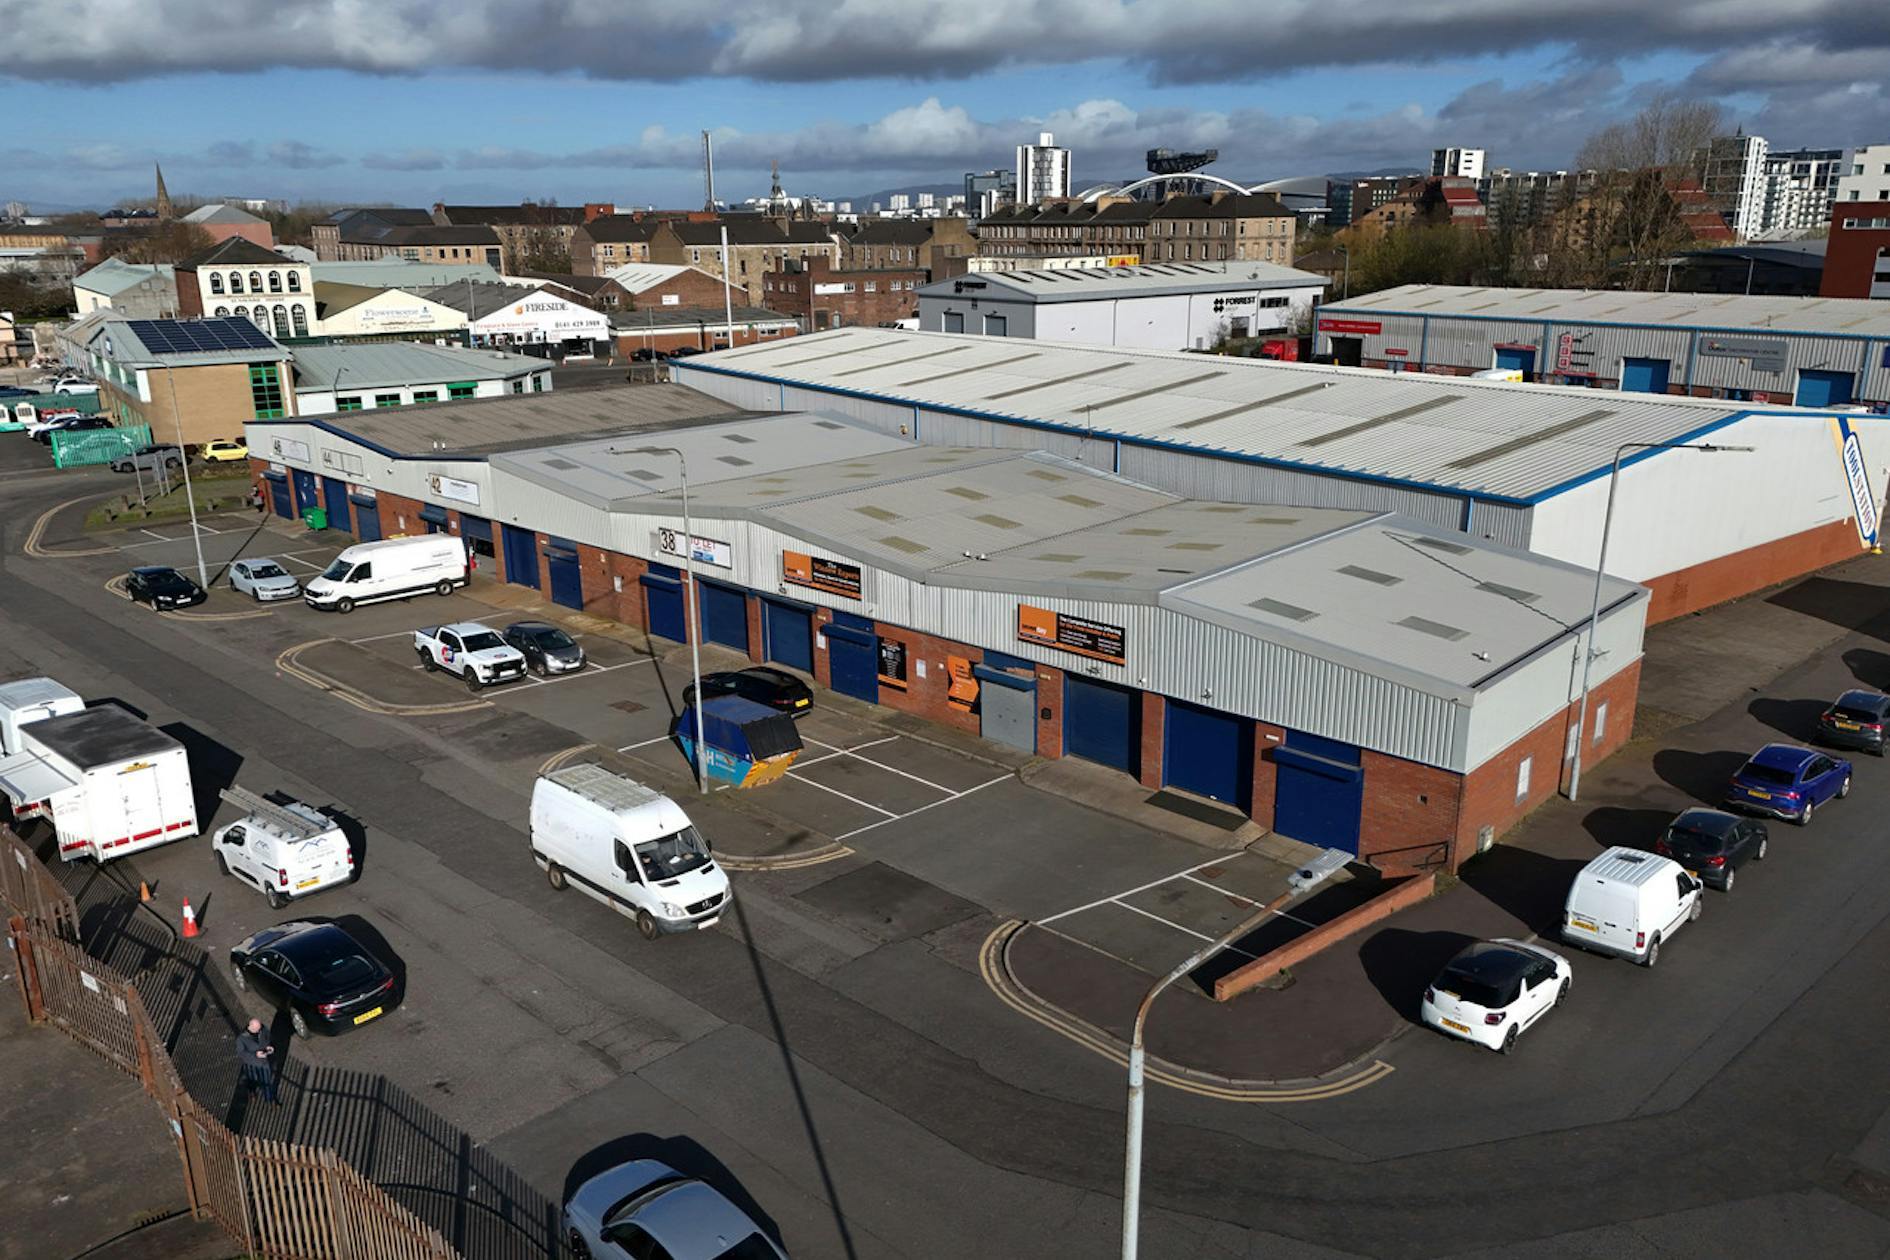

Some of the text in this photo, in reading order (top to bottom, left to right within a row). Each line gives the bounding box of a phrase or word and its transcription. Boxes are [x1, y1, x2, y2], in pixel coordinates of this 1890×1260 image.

[525, 302, 569, 313] FIRESIDE
[1225, 296, 1256, 305] FORREST
[432, 476, 442, 494] 42
[1846, 440, 1873, 534] TOOLSTATION
[661, 531, 676, 551] 38
[703, 538, 716, 550] LET
